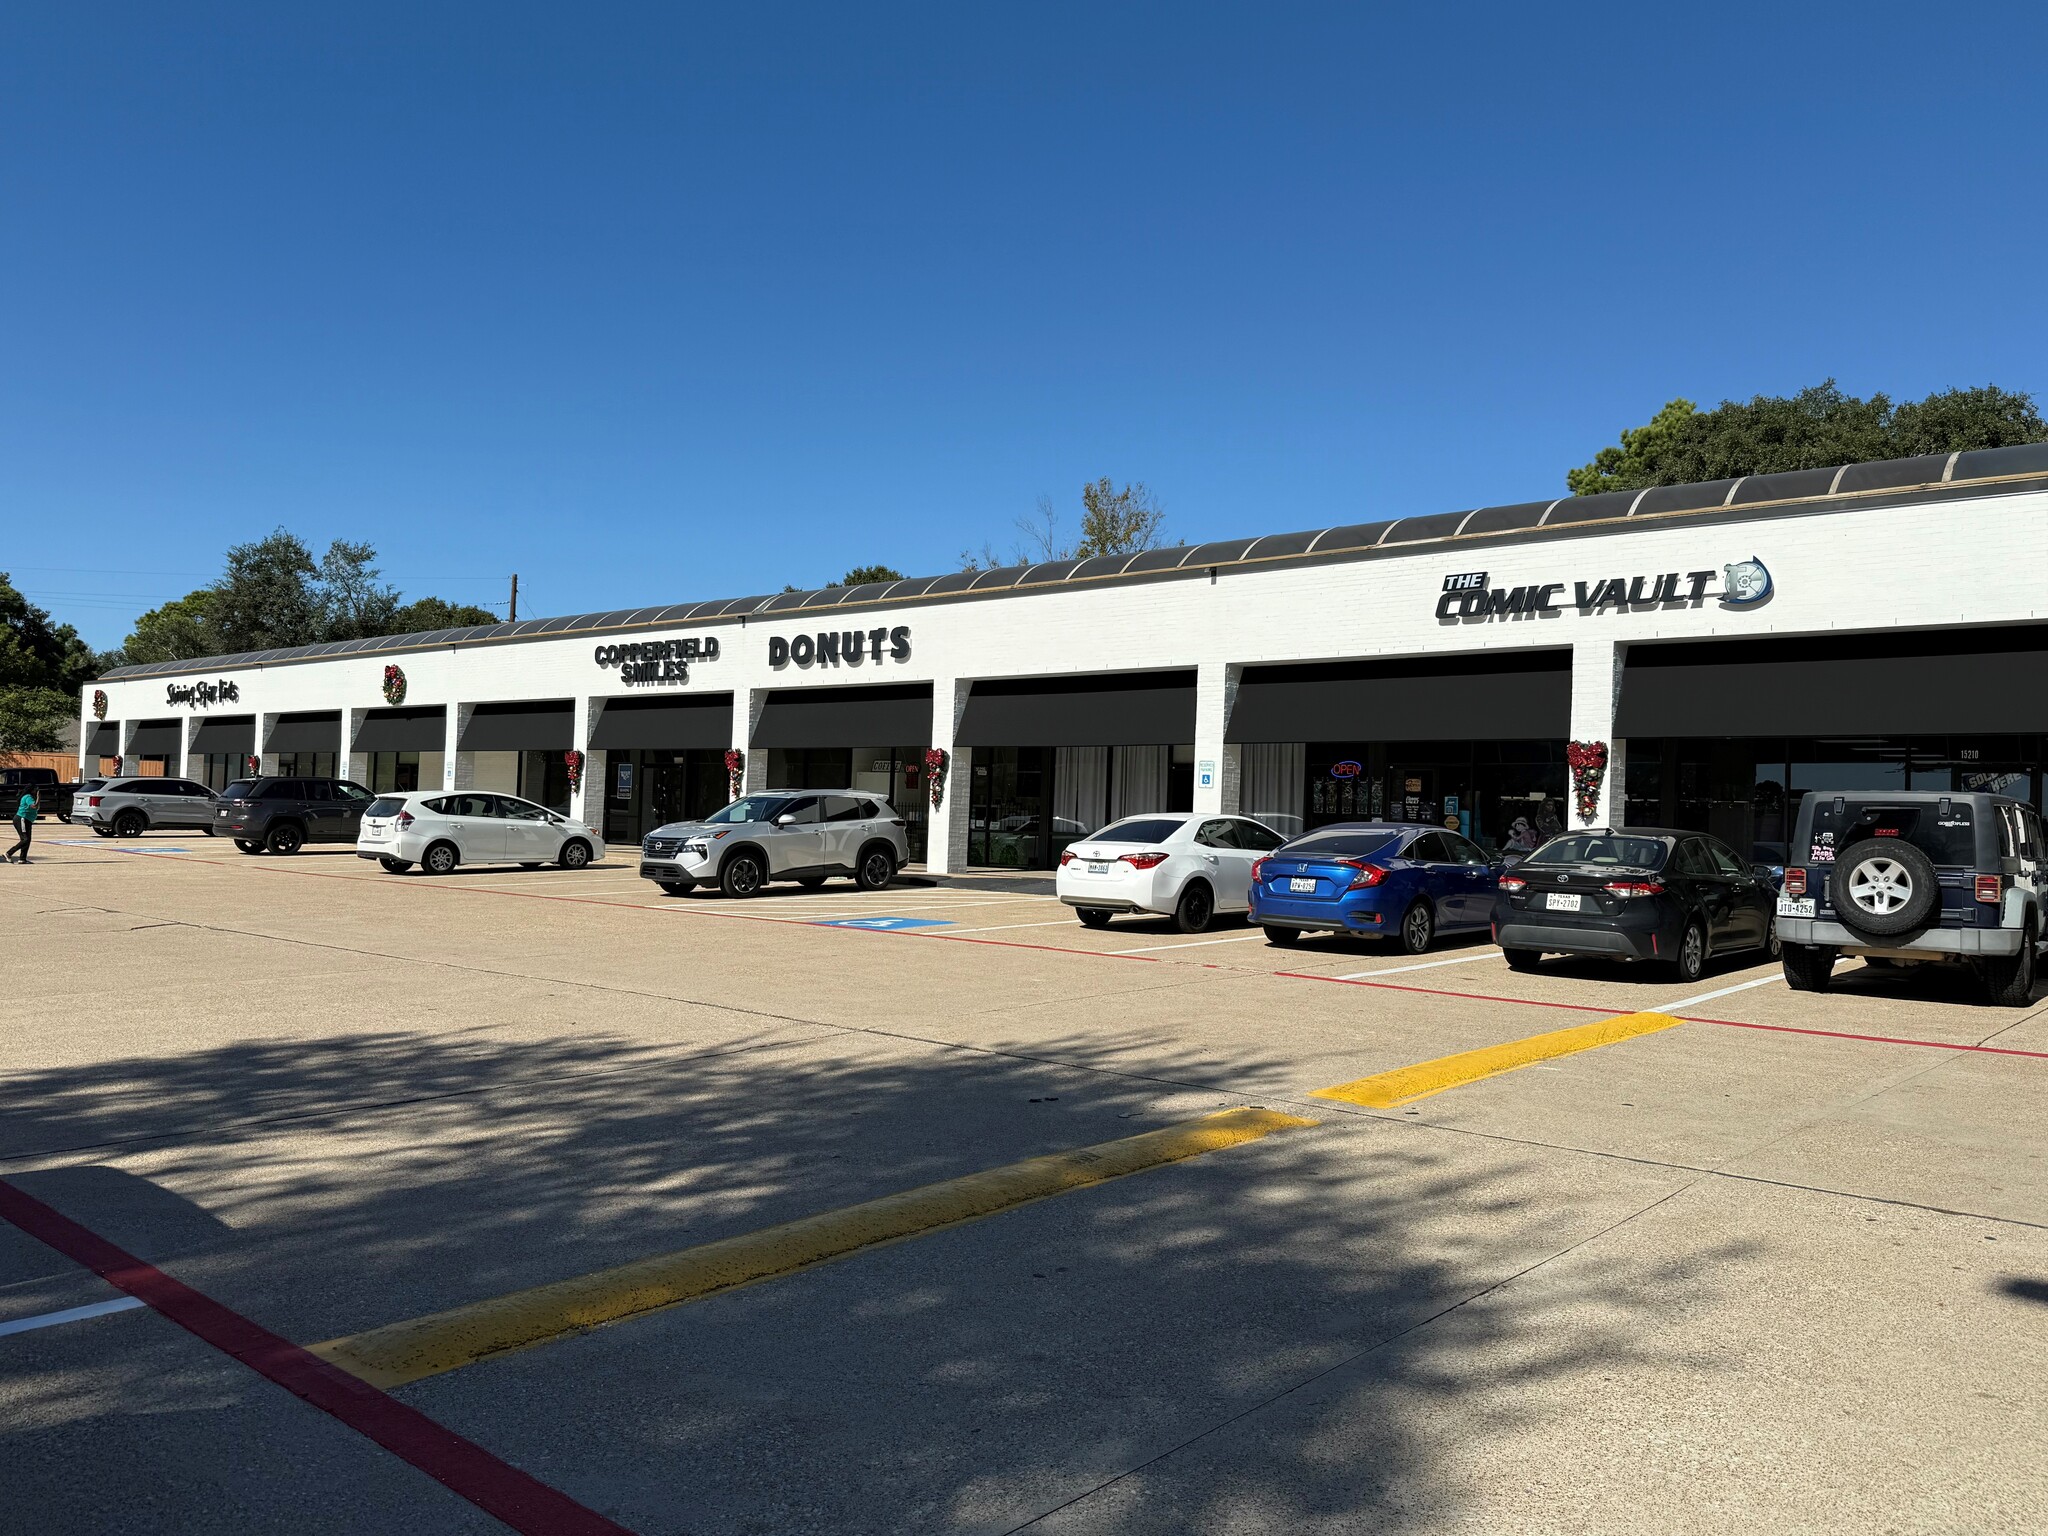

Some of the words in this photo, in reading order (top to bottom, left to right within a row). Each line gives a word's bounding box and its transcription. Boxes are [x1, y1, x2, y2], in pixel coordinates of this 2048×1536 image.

[1445, 573, 1483, 590] THE
[1435, 583, 1564, 619] COMIC
[1574, 570, 1716, 609] VAULT
[595, 637, 719, 665] COPPERFIELD
[769, 626, 910, 666] DONUTS
[621, 661, 688, 683] SMILES
[1961, 750, 1979, 759] 15210
[873, 761, 901, 770] COFFE
[905, 765, 919, 773] OPEN
[1333, 764, 1359, 775] OPEN
